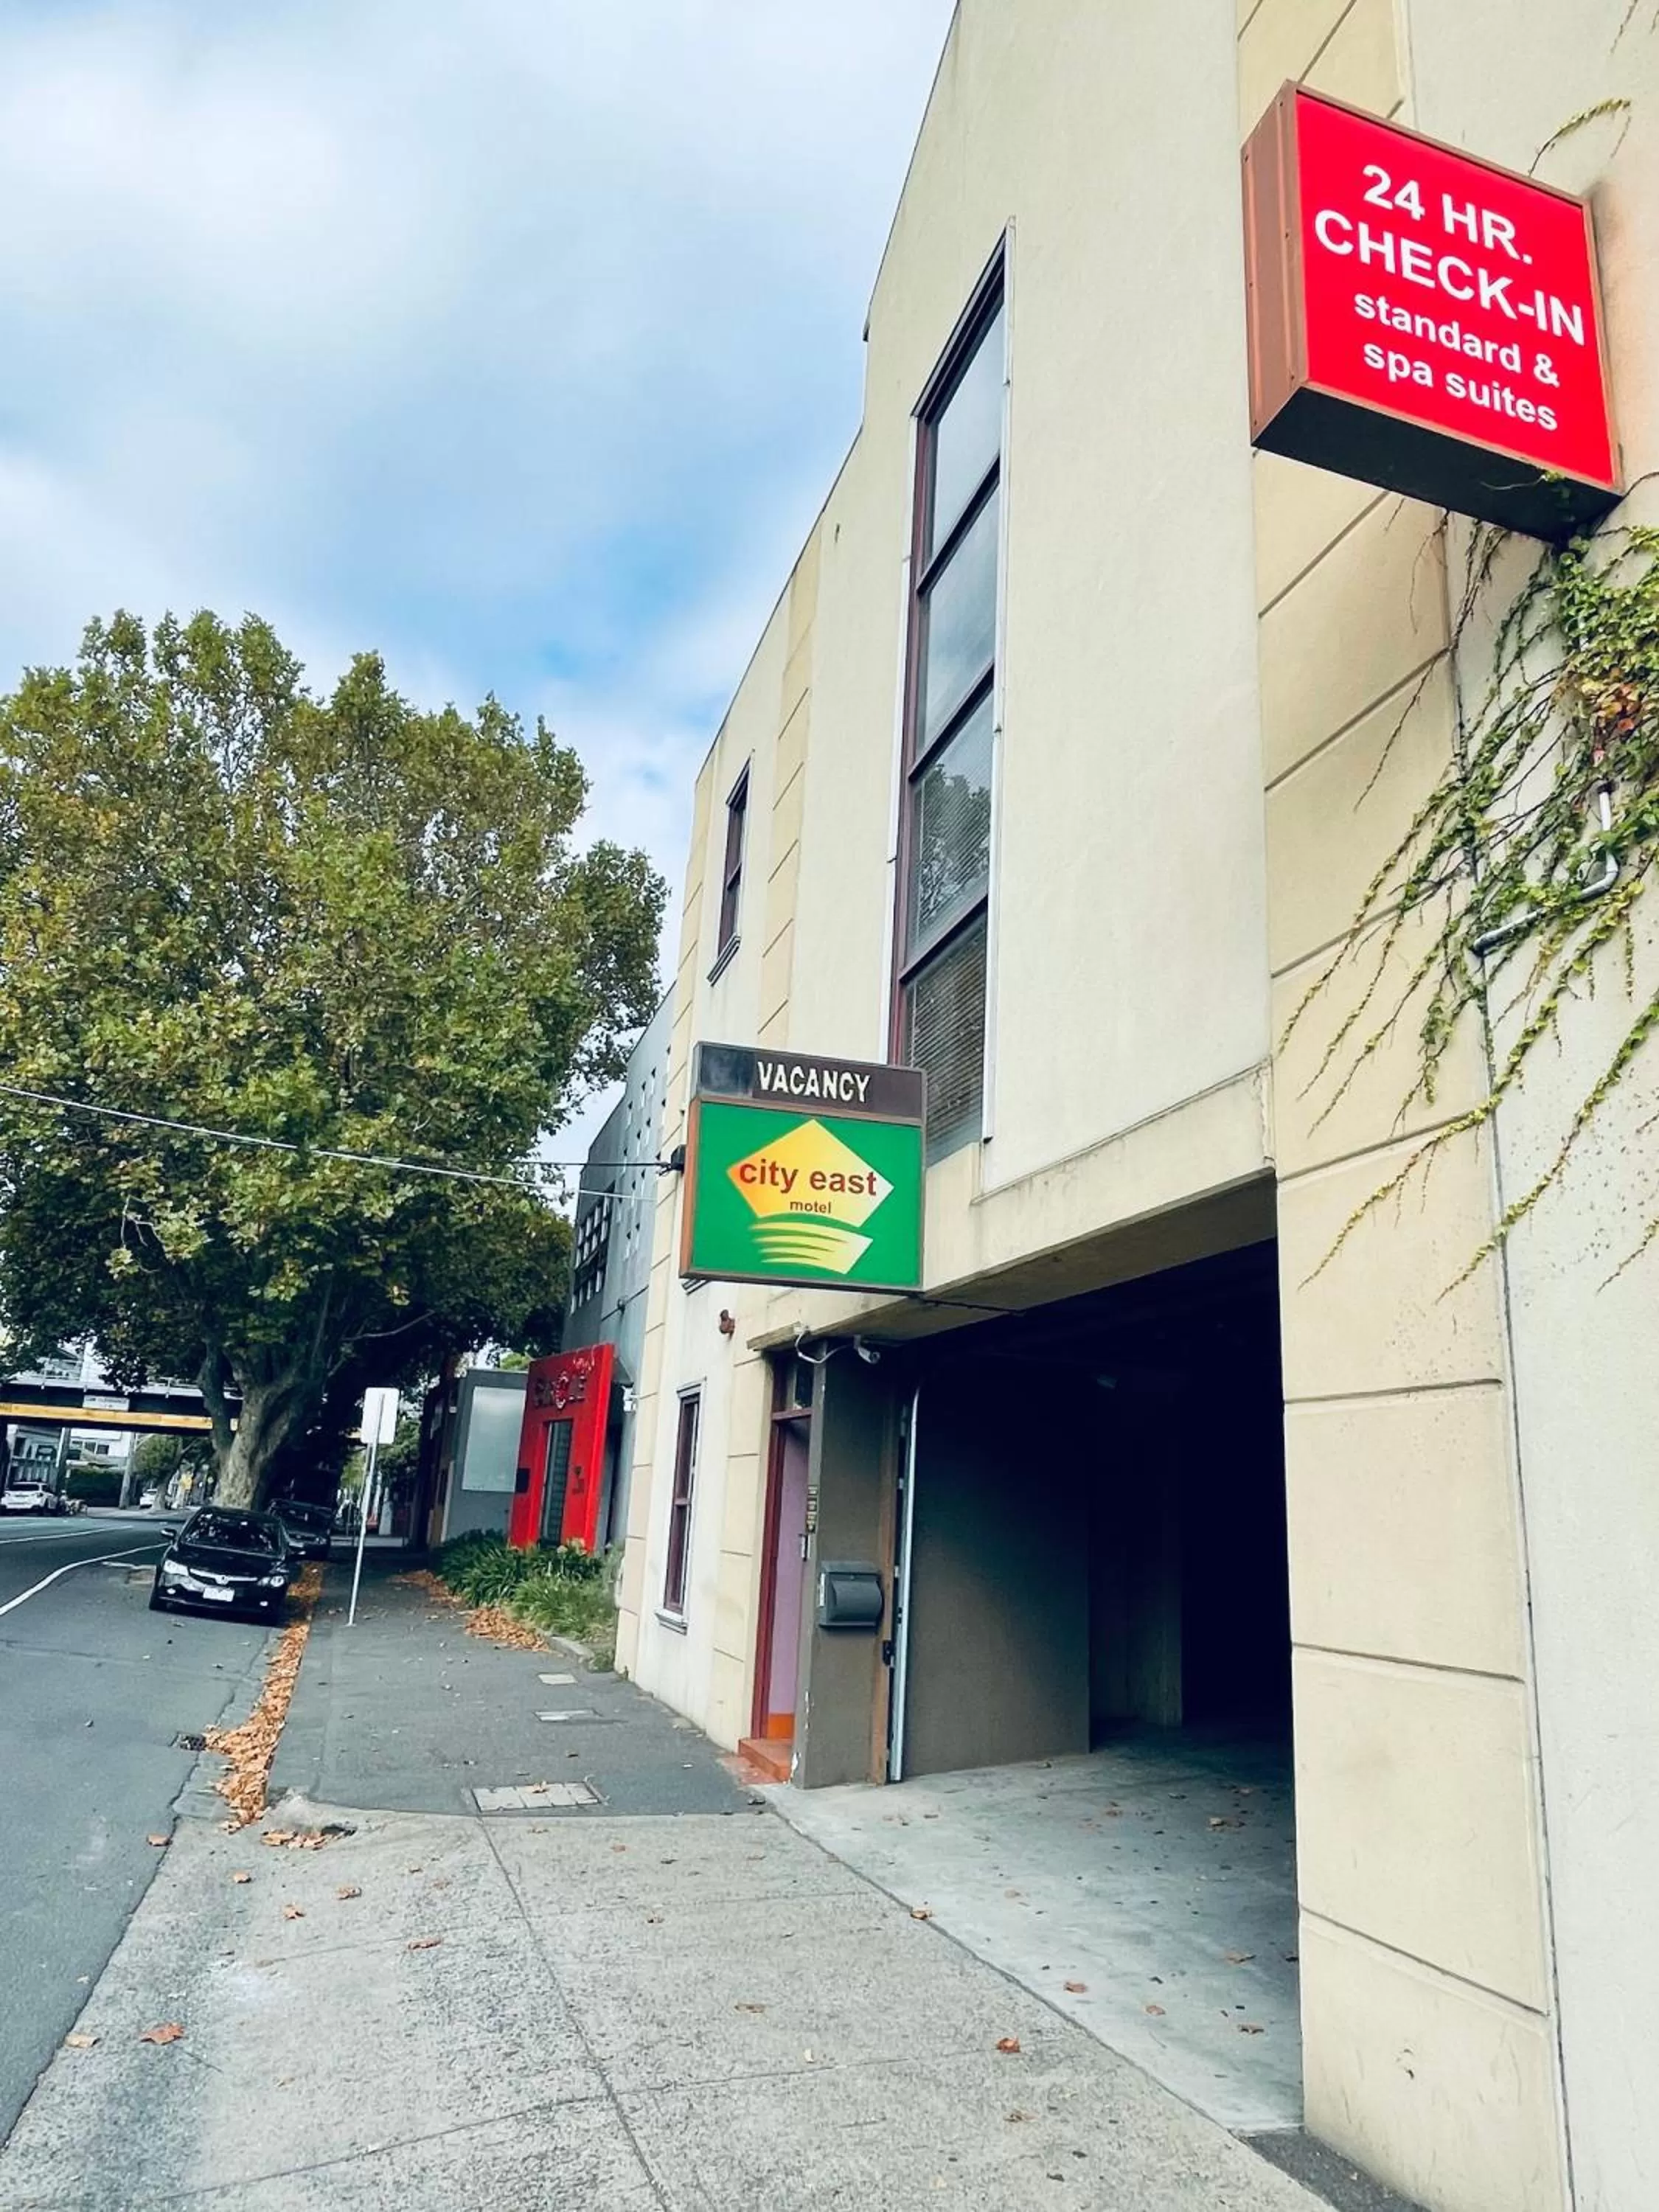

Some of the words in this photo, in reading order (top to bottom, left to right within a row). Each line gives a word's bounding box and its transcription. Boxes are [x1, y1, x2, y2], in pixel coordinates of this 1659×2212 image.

[1362, 164, 1426, 221] 24
[1441, 193, 1533, 265] HR.
[1314, 209, 1585, 347] CHECK-IN
[1354, 292, 1522, 374] standard
[1532, 352, 1560, 388] &
[1363, 343, 1434, 388] spa
[1445, 371, 1558, 431] suites
[757, 1060, 871, 1103] VACANCY
[738, 1158, 799, 1194] city
[809, 1170, 877, 1196] east
[789, 1200, 832, 1214] motel
